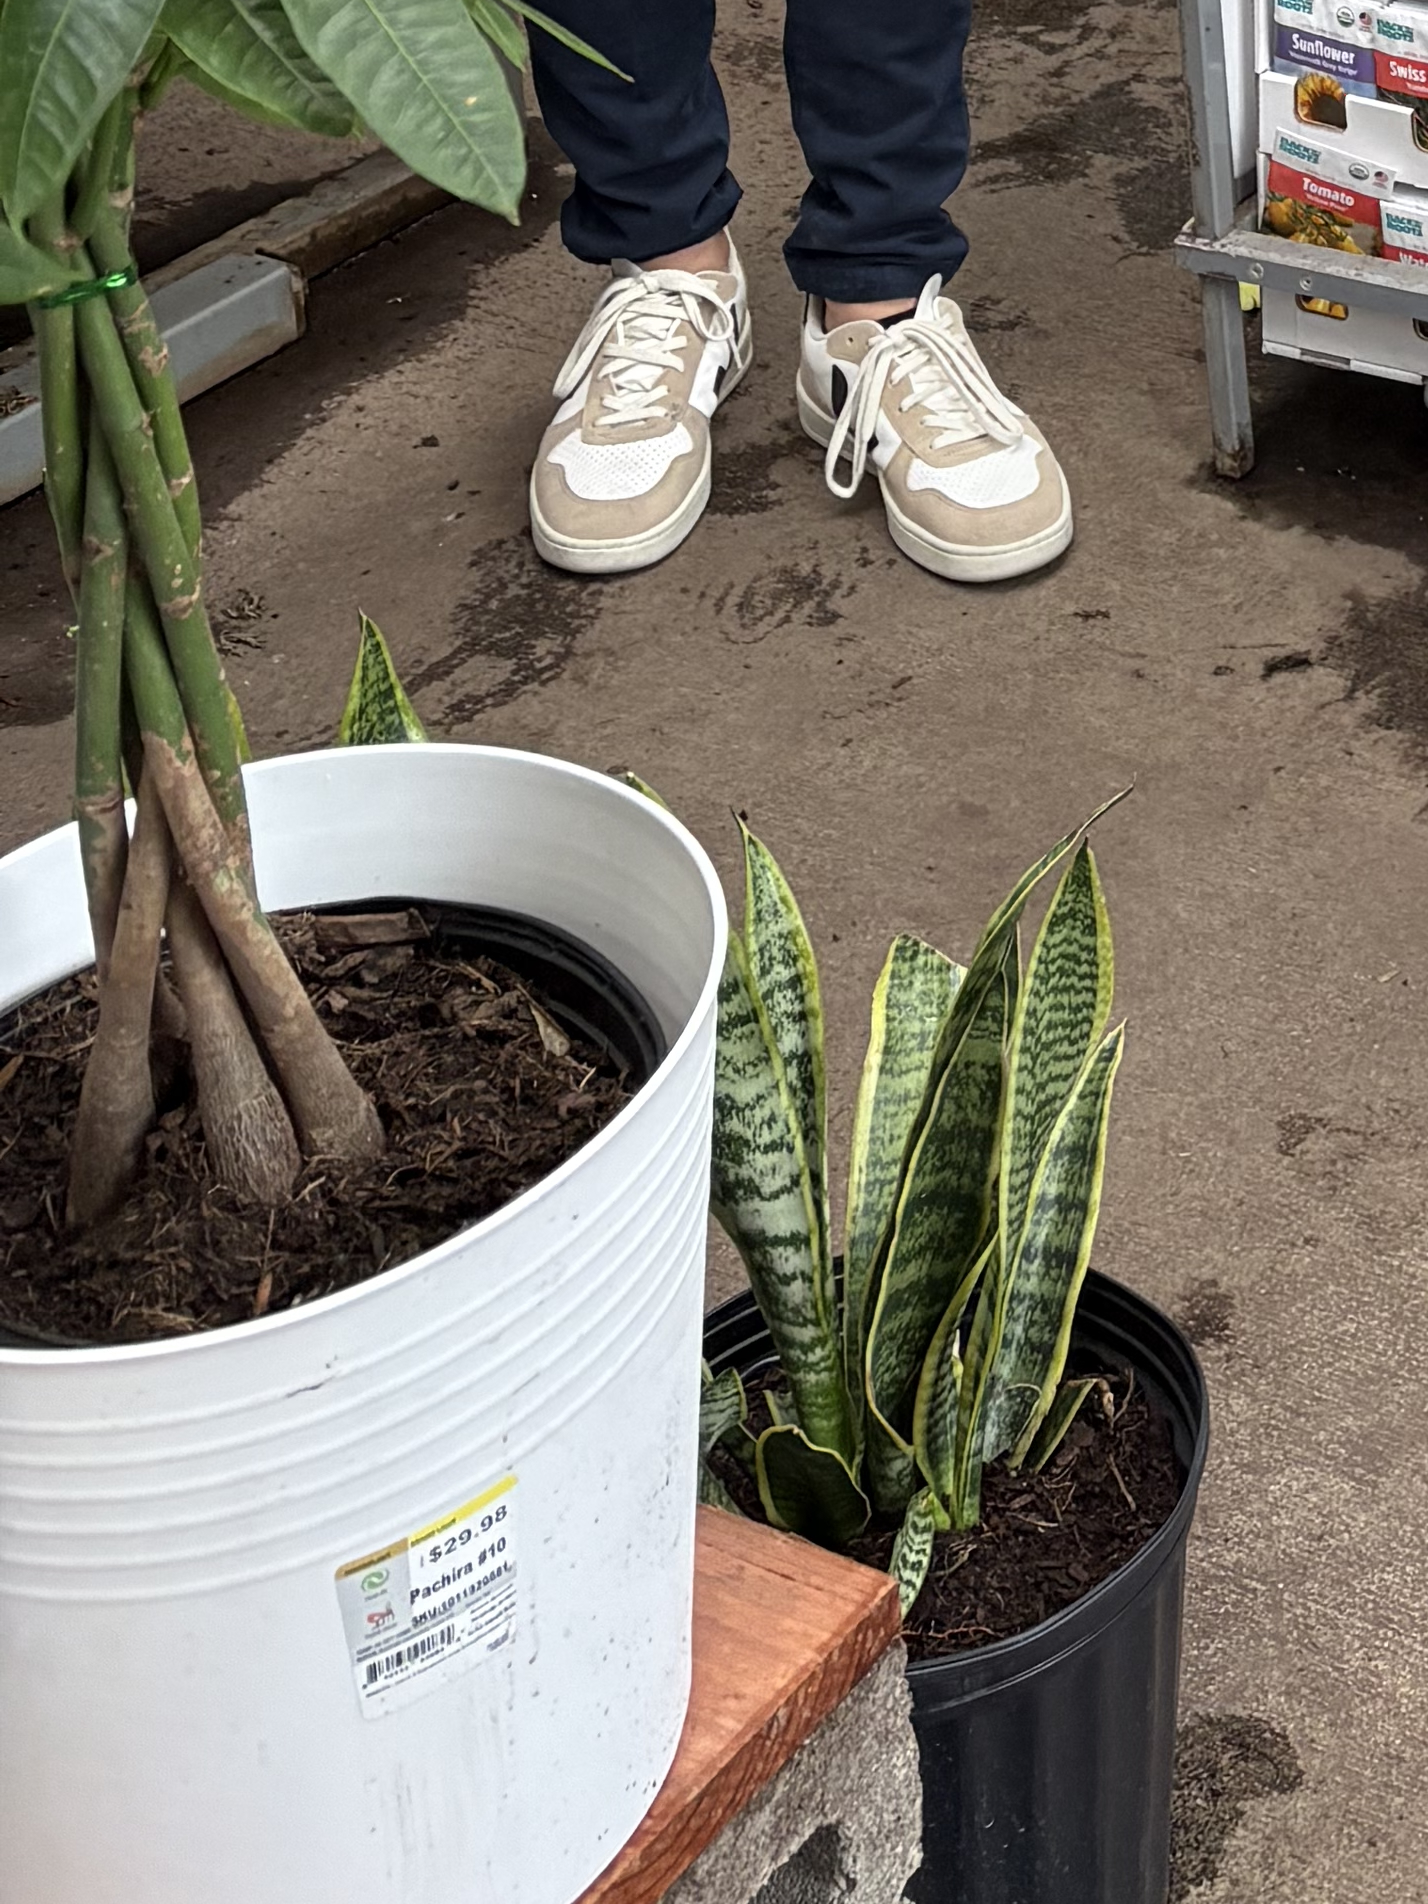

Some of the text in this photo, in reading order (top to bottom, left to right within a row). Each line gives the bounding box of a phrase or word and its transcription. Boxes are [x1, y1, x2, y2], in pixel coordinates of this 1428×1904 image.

[1390, 61, 1426, 82] Swiss
[429, 1505, 507, 1563] $29.98
[410, 1560, 473, 1604] Pachira
[478, 1536, 506, 1566] #10
